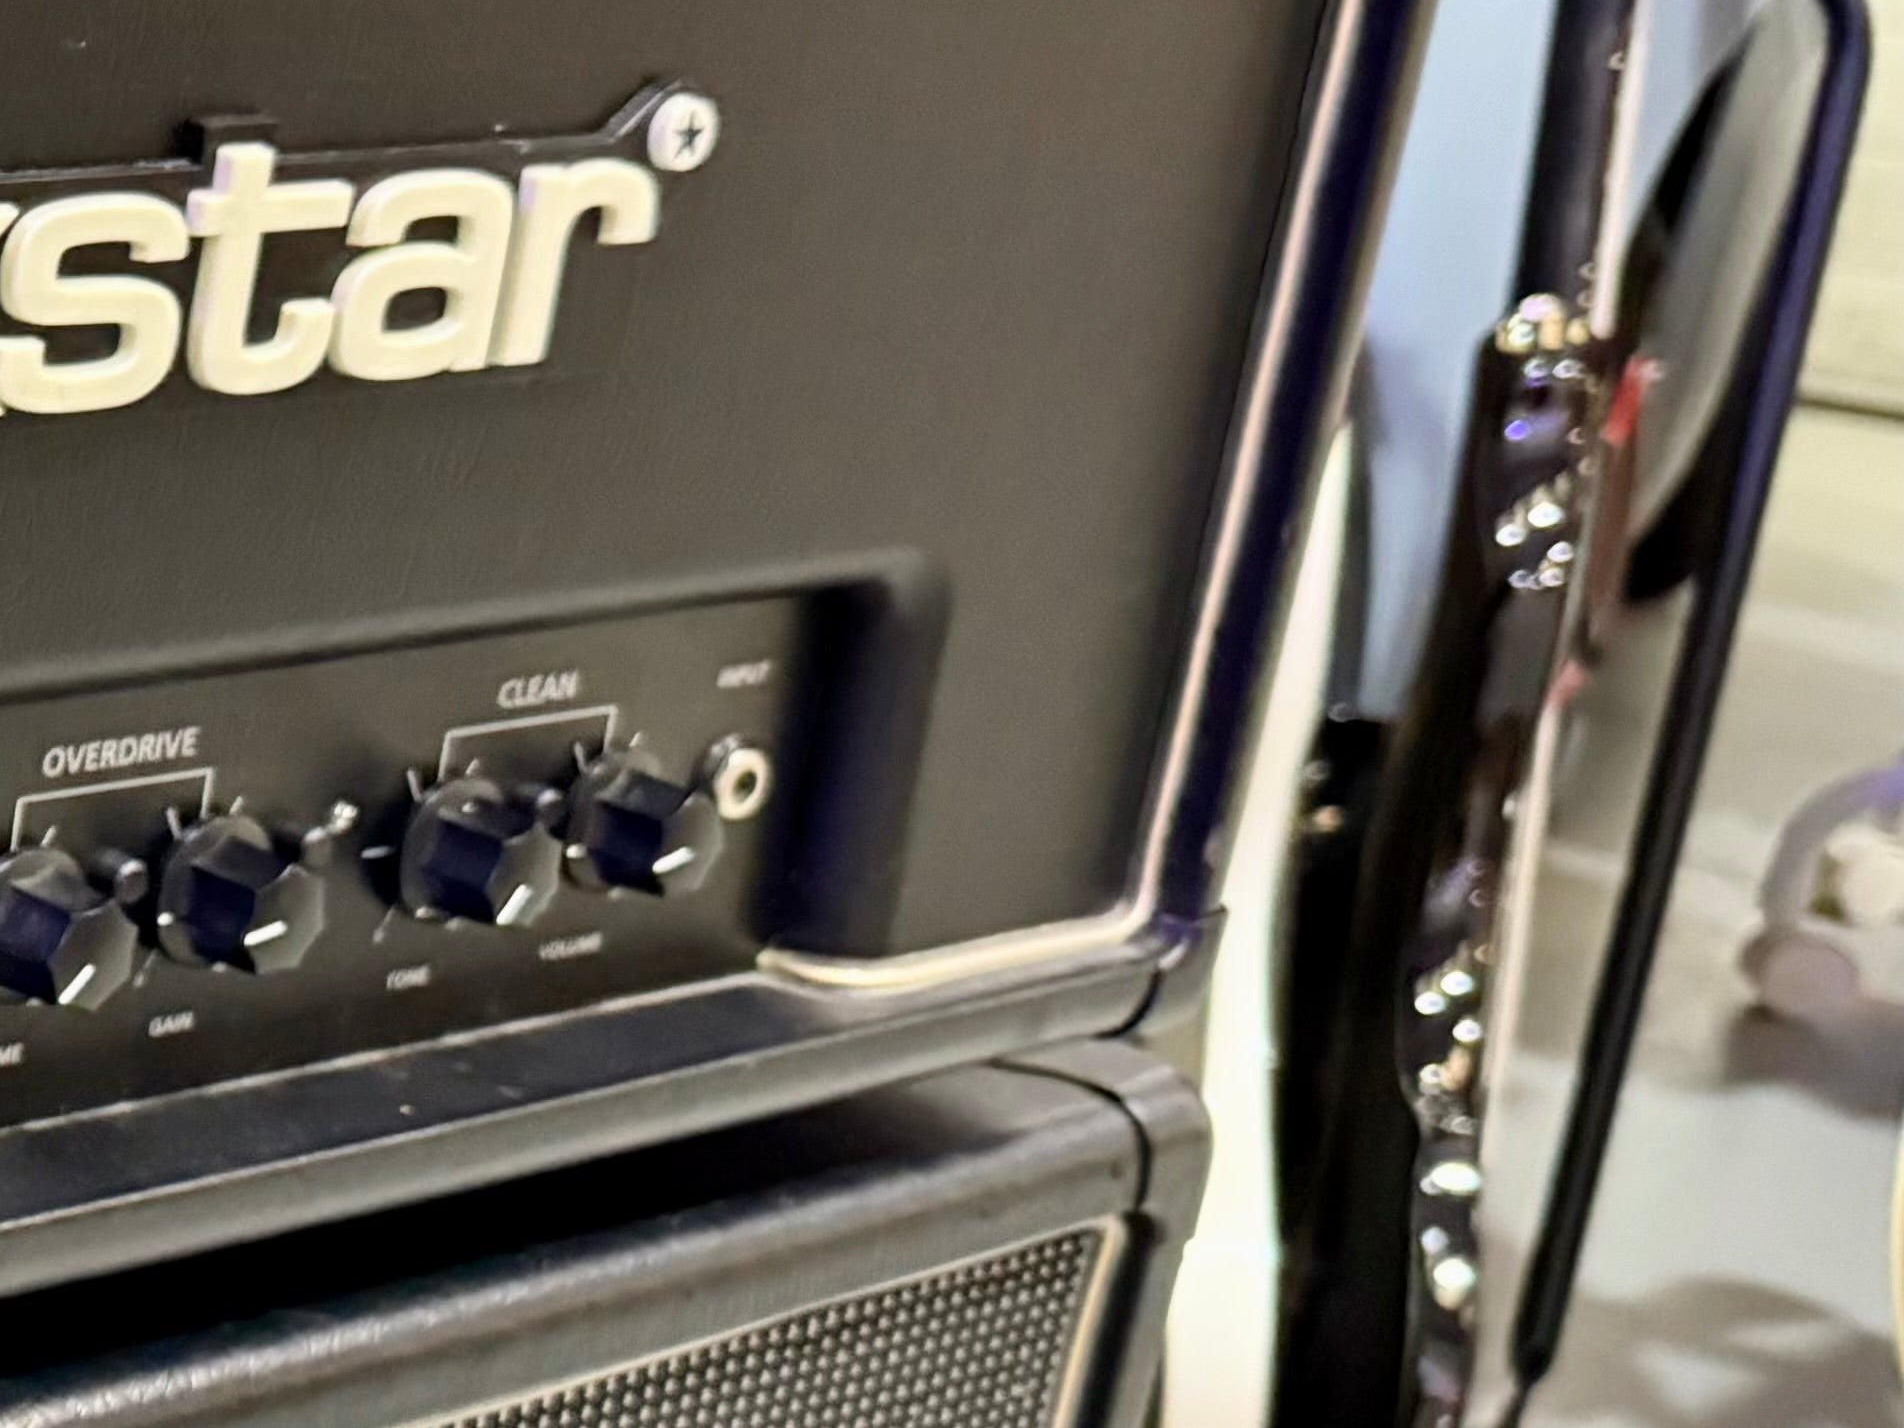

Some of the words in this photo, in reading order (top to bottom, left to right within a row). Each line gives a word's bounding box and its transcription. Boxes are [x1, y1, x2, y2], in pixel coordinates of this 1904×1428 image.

[496, 670, 580, 709] CLEAN
[41, 725, 201, 778] OVERDRIVE
[539, 932, 603, 961] VOLUME
[148, 1010, 194, 1037] GAIN
